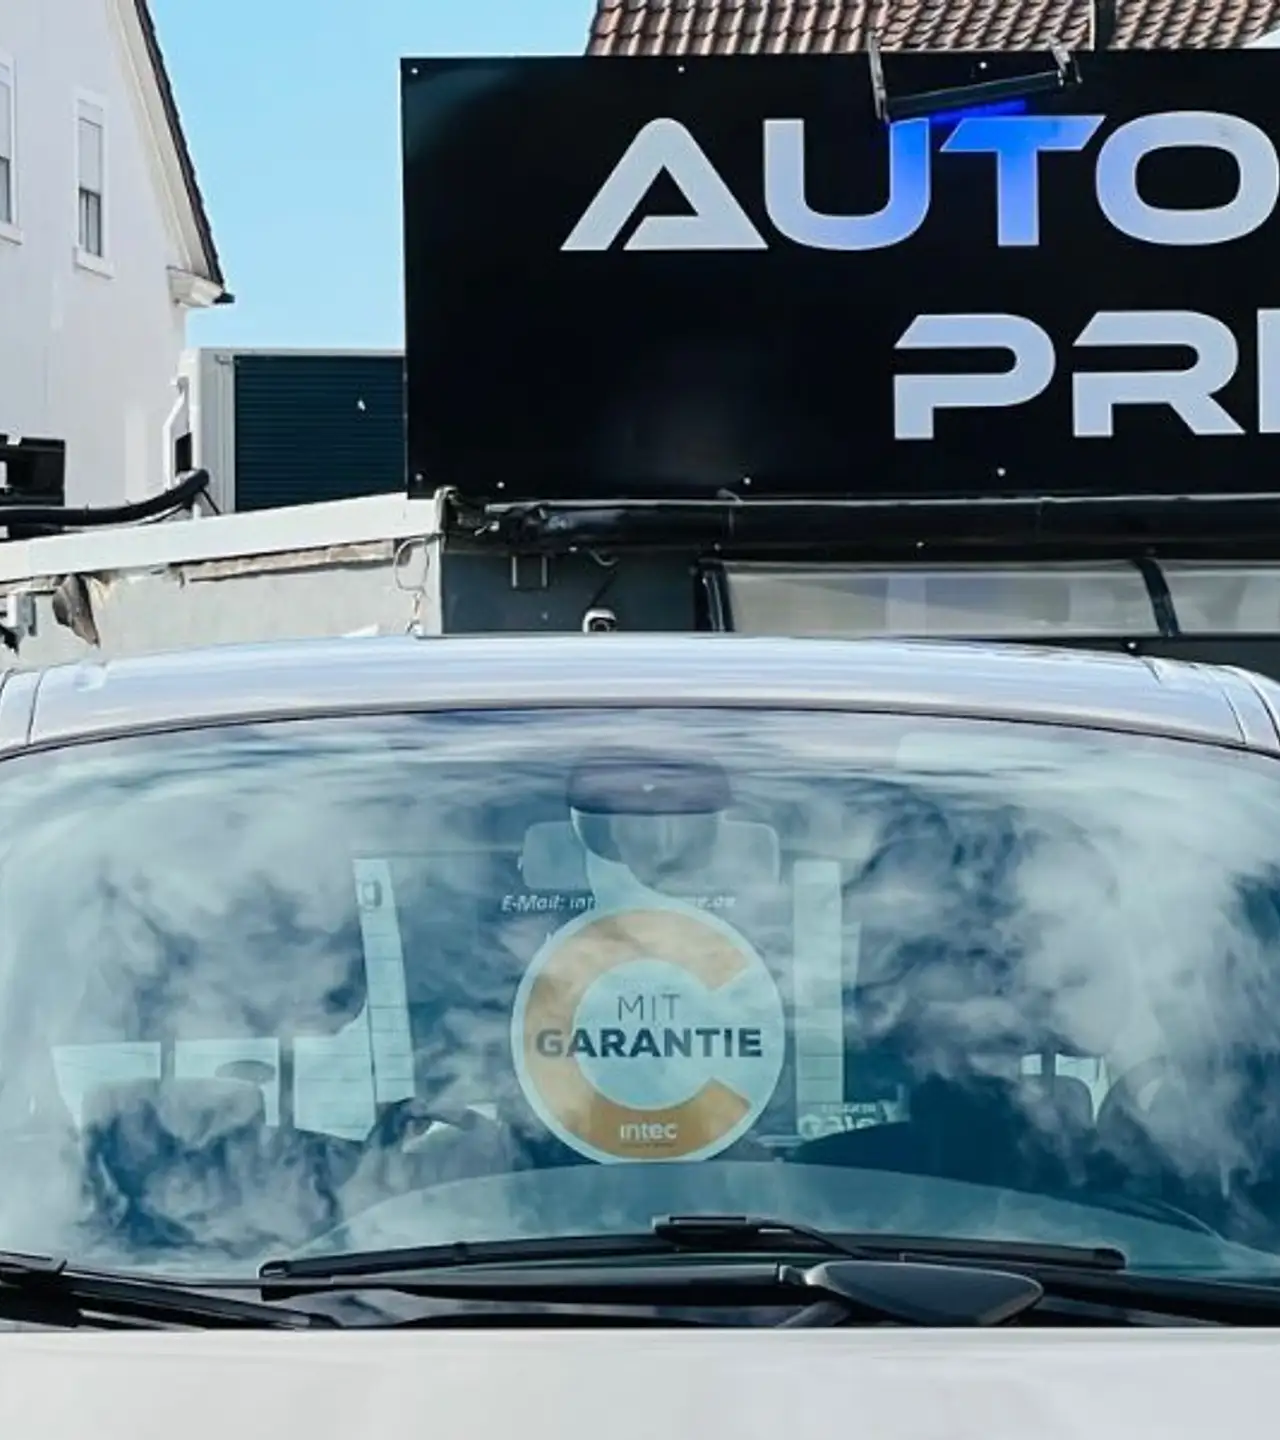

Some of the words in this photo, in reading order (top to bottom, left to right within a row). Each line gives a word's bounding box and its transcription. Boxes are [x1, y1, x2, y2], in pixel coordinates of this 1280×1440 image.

[617, 993, 680, 1021] MIT
[535, 1028, 764, 1058] GARANTIE
[620, 1122, 678, 1140] intec
